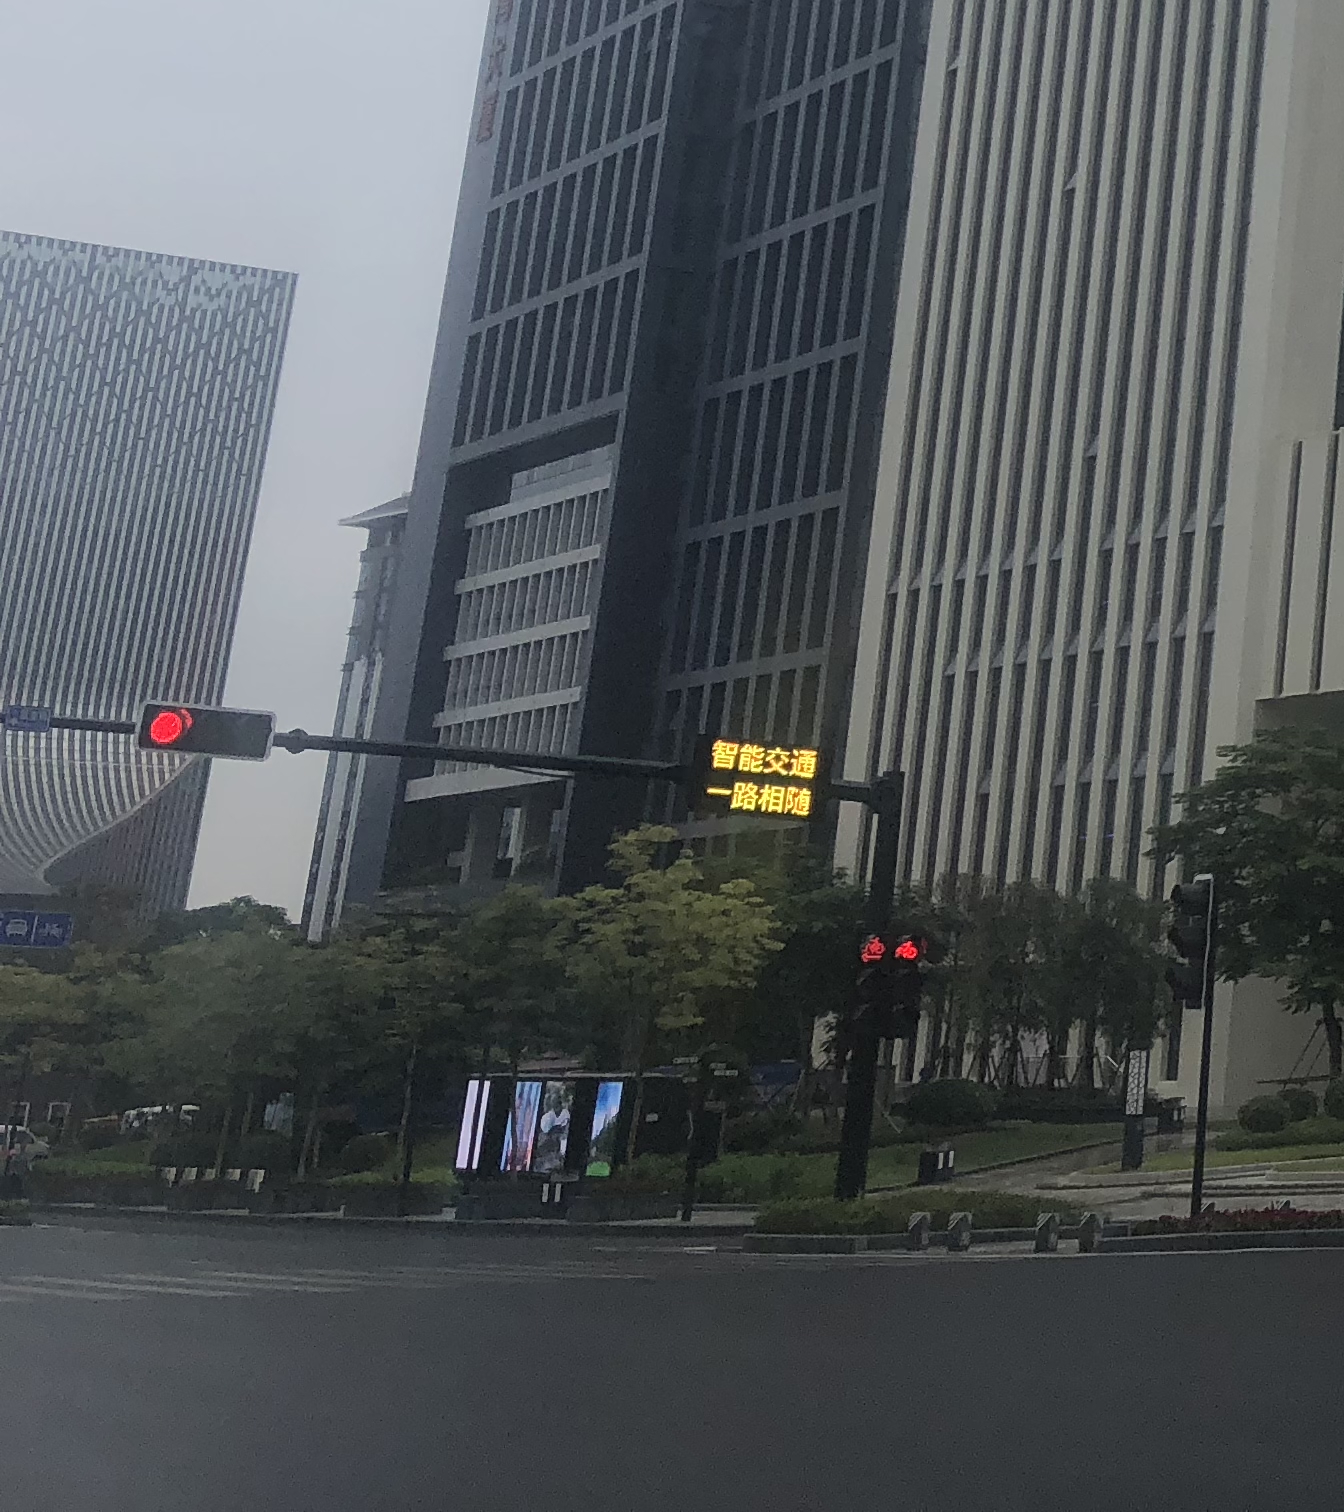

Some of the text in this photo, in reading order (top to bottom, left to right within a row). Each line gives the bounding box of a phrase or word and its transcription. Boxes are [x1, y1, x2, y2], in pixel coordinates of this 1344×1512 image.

[711, 739, 818, 779] 智能交通
[706, 781, 812, 817] 一路相随
